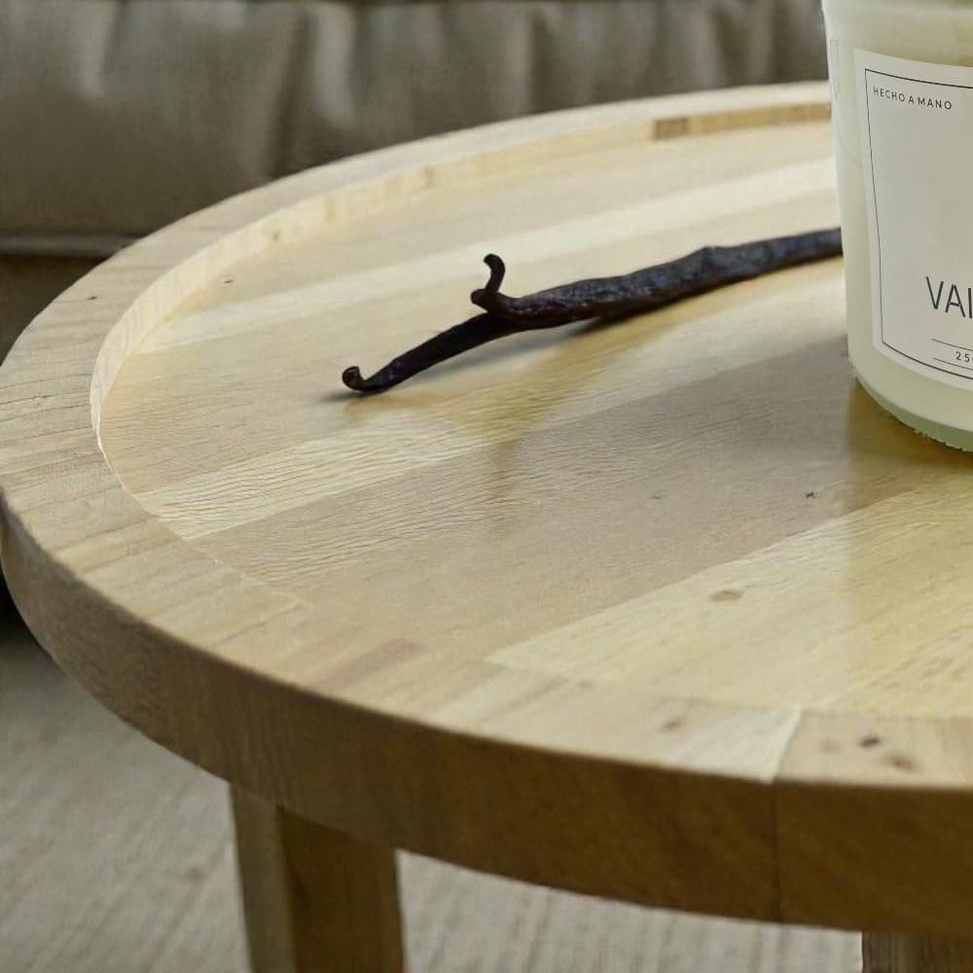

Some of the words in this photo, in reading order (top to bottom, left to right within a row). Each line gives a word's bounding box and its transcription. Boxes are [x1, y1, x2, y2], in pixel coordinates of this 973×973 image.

[873, 86, 905, 102] HECHO
[908, 96, 915, 105] A
[918, 97, 953, 110] MANO
